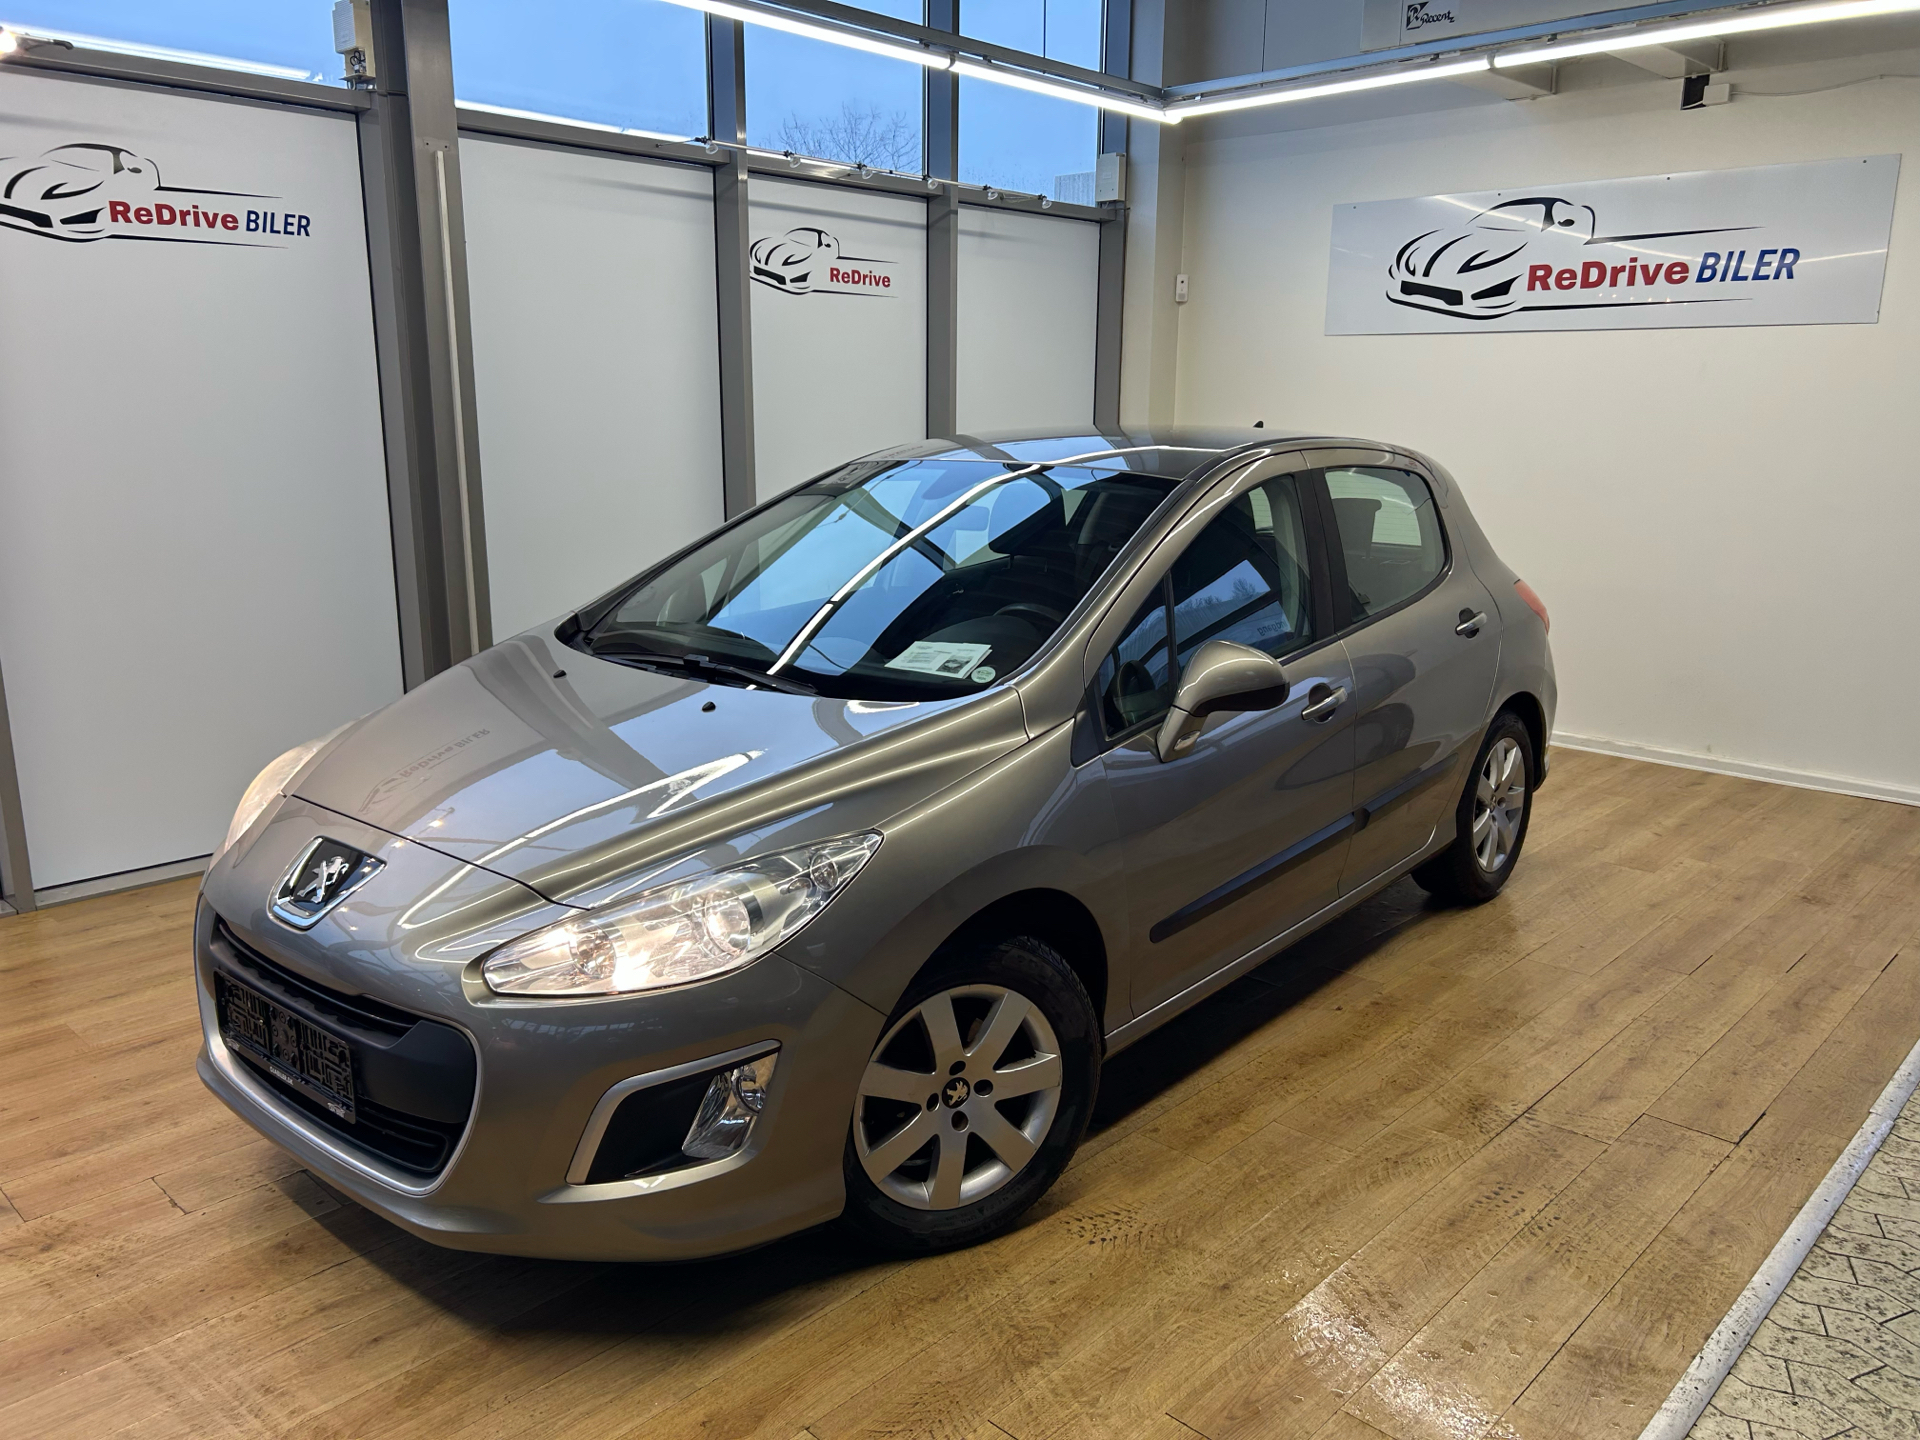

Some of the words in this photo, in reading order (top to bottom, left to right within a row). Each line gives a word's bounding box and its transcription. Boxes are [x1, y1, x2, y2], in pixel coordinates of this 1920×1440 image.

[109, 201, 239, 231] ReDrive
[245, 210, 311, 237] BILER
[829, 267, 892, 288] ReDrive
[1527, 257, 1690, 291] ReDrive
[1695, 248, 1801, 283] BILER
